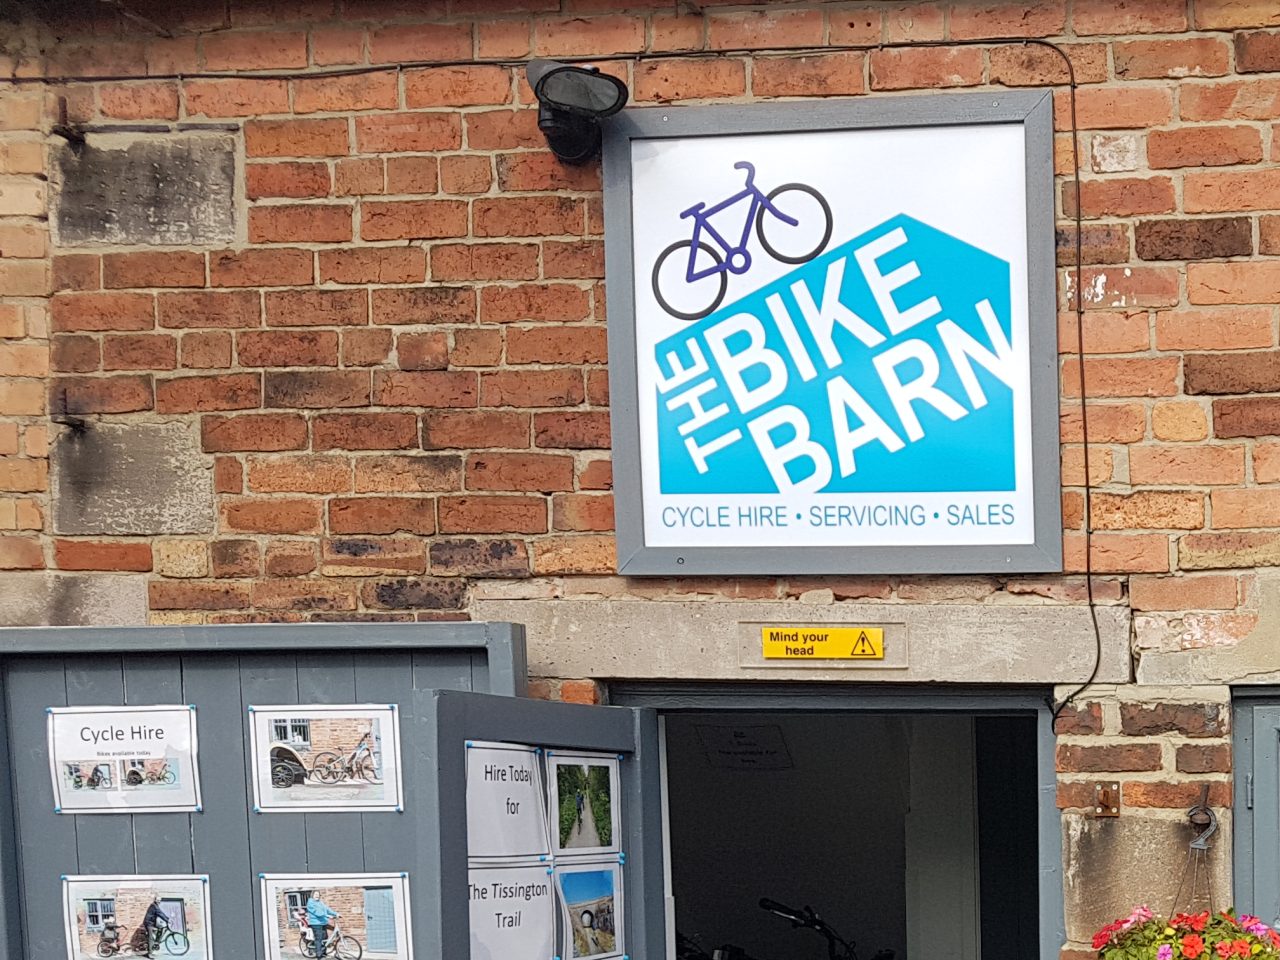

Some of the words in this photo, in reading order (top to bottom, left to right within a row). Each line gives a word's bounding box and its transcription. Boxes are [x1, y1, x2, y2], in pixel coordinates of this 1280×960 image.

[703, 226, 942, 415] BIKE
[656, 338, 742, 474] THE
[746, 298, 1015, 495] BARN
[662, 505, 731, 528] CYCLE
[738, 505, 788, 527] HIRE
[809, 504, 926, 527] SERVICING
[947, 504, 1015, 526] SALES
[769, 631, 799, 642] Mind
[802, 633, 829, 644] your
[785, 645, 815, 656] head
[80, 725, 125, 744] Cycle
[131, 725, 165, 741] Hire
[484, 764, 507, 782] Hire
[508, 764, 533, 786] Today
[506, 797, 520, 815] for
[468, 883, 488, 900] The
[491, 883, 548, 901] Tissington
[495, 911, 521, 929] Trail
